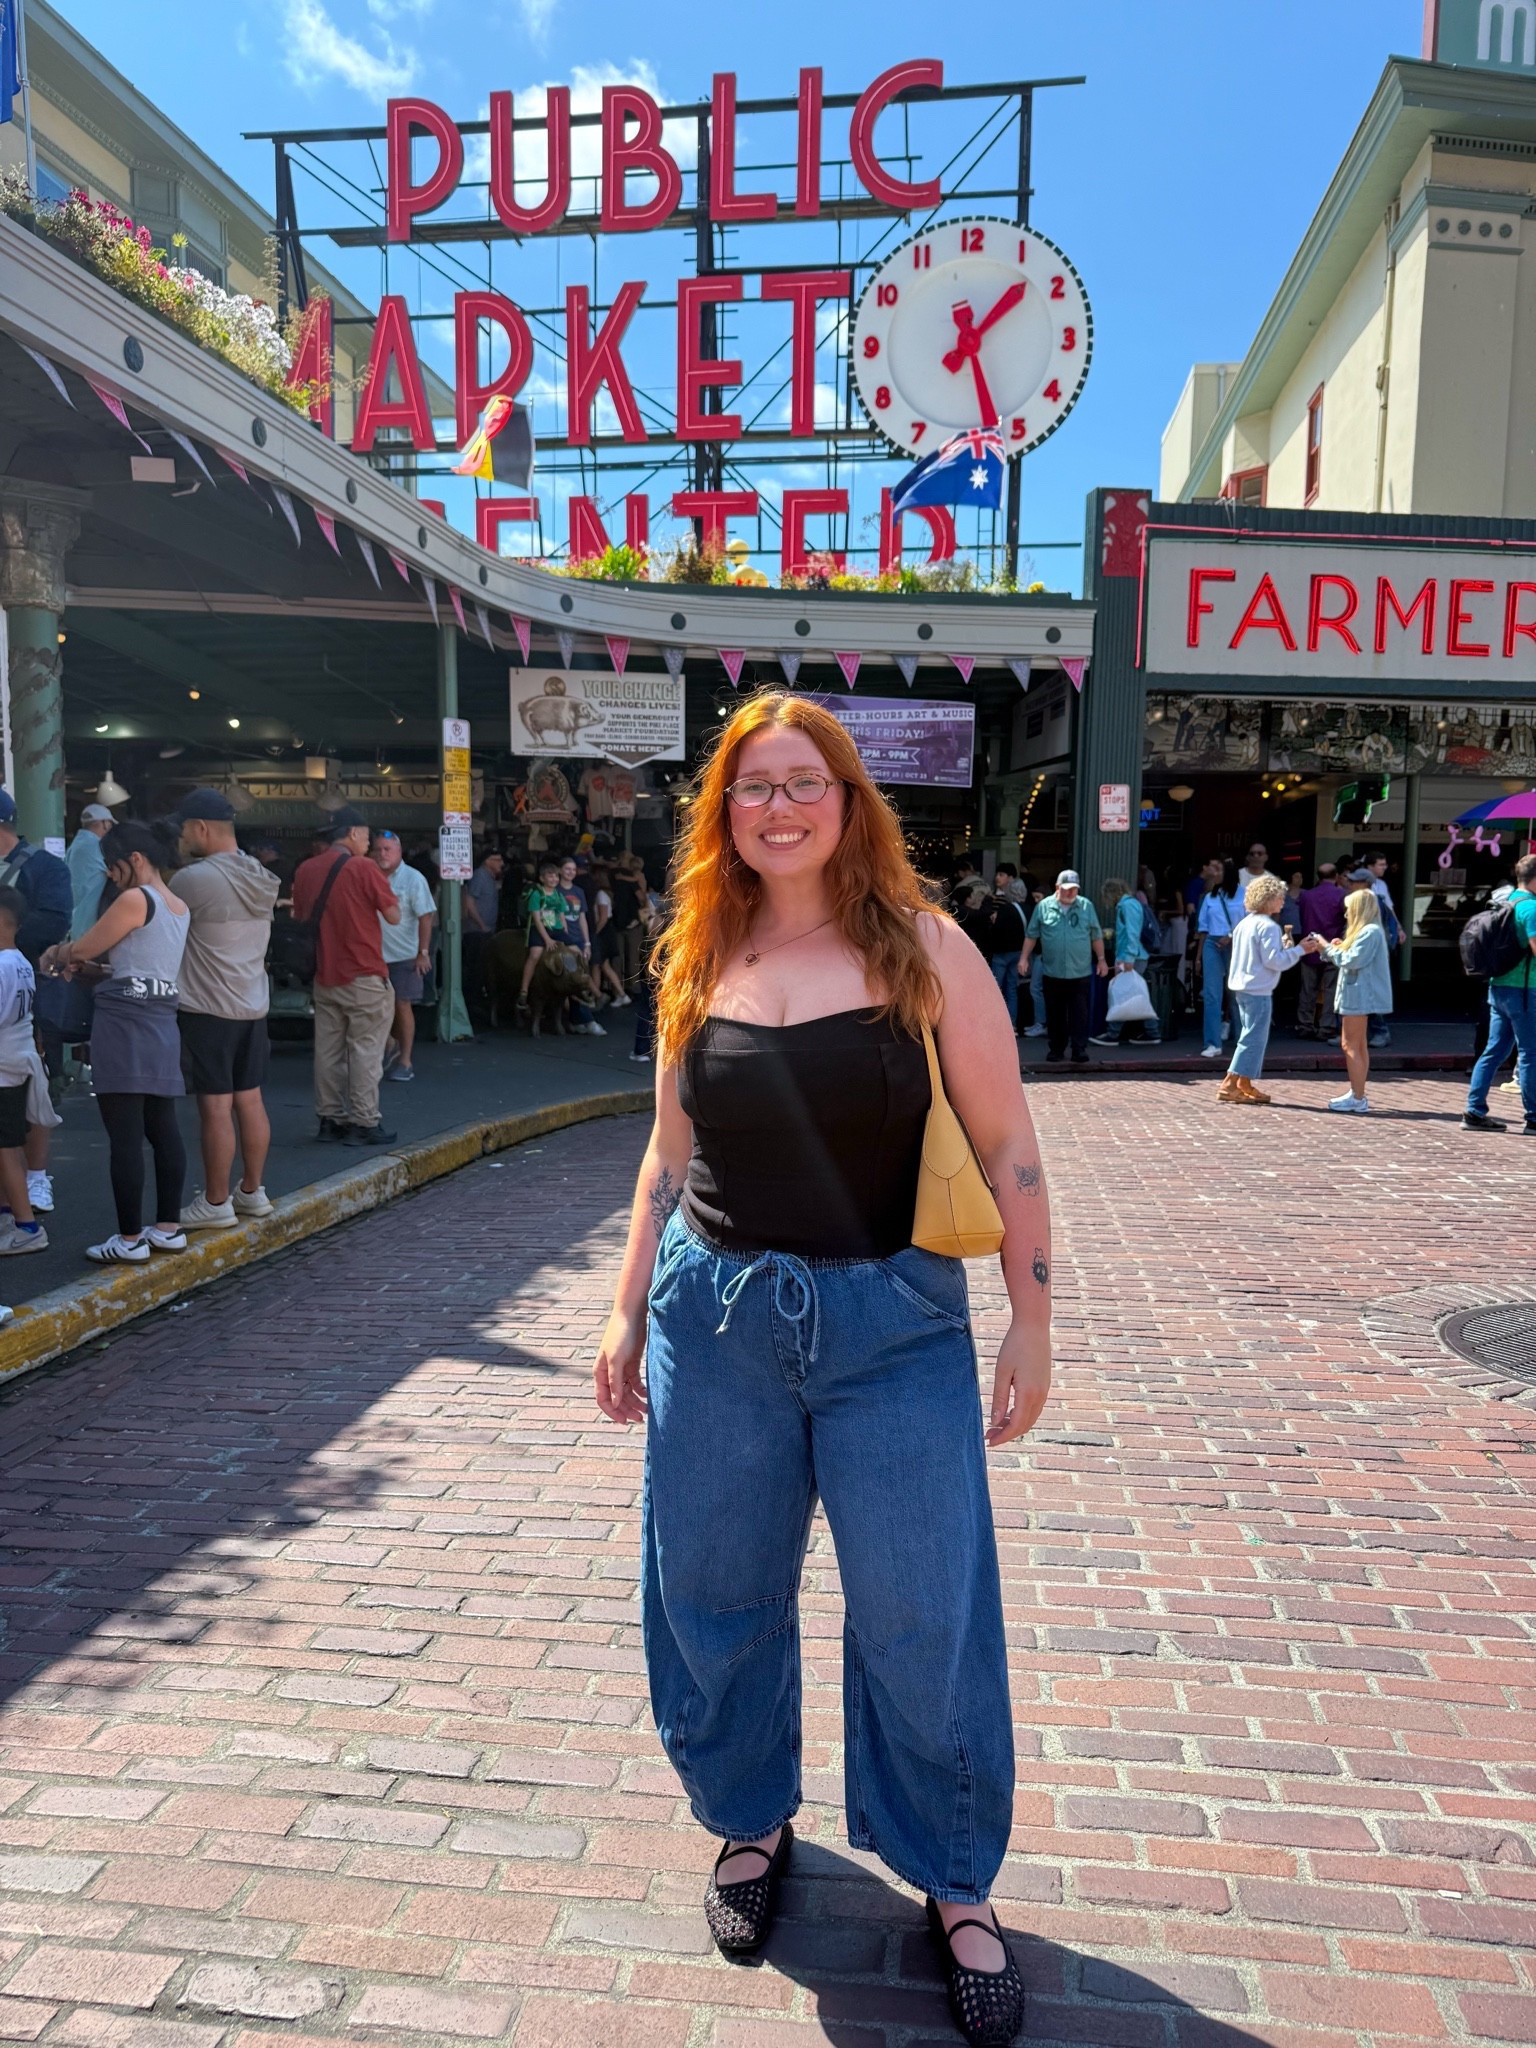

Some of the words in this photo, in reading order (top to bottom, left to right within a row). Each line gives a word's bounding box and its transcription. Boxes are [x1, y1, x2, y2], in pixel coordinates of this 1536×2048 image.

[387, 59, 943, 241] PUBLIC
[961, 228, 984, 252] 12
[914, 245, 930, 269] 11
[1018, 240, 1025, 264] 1
[877, 284, 898, 307] 10
[1050, 276, 1065, 299] 2
[863, 336, 880, 358] 9
[1061, 326, 1076, 351] 3
[875, 386, 891, 410] 8
[1043, 379, 1061, 402] 4
[911, 422, 927, 444] 7
[1010, 418, 1026, 440] 5
[1187, 568, 1536, 658] FARMER
[582, 680, 622, 699] YOUR
[622, 681, 681, 701] CHANGE
[599, 700, 646, 709] CHANGES
[648, 702, 681, 710] LIVES!
[837, 711, 903, 721] FTER-HOURS
[907, 711, 927, 719] ART
[931, 710, 938, 718] &
[943, 710, 973, 718] MUSIC
[875, 727, 925, 739] FRIDAY!
[600, 744, 636, 752] DONATE
[888, 751, 909, 760] 9PM
